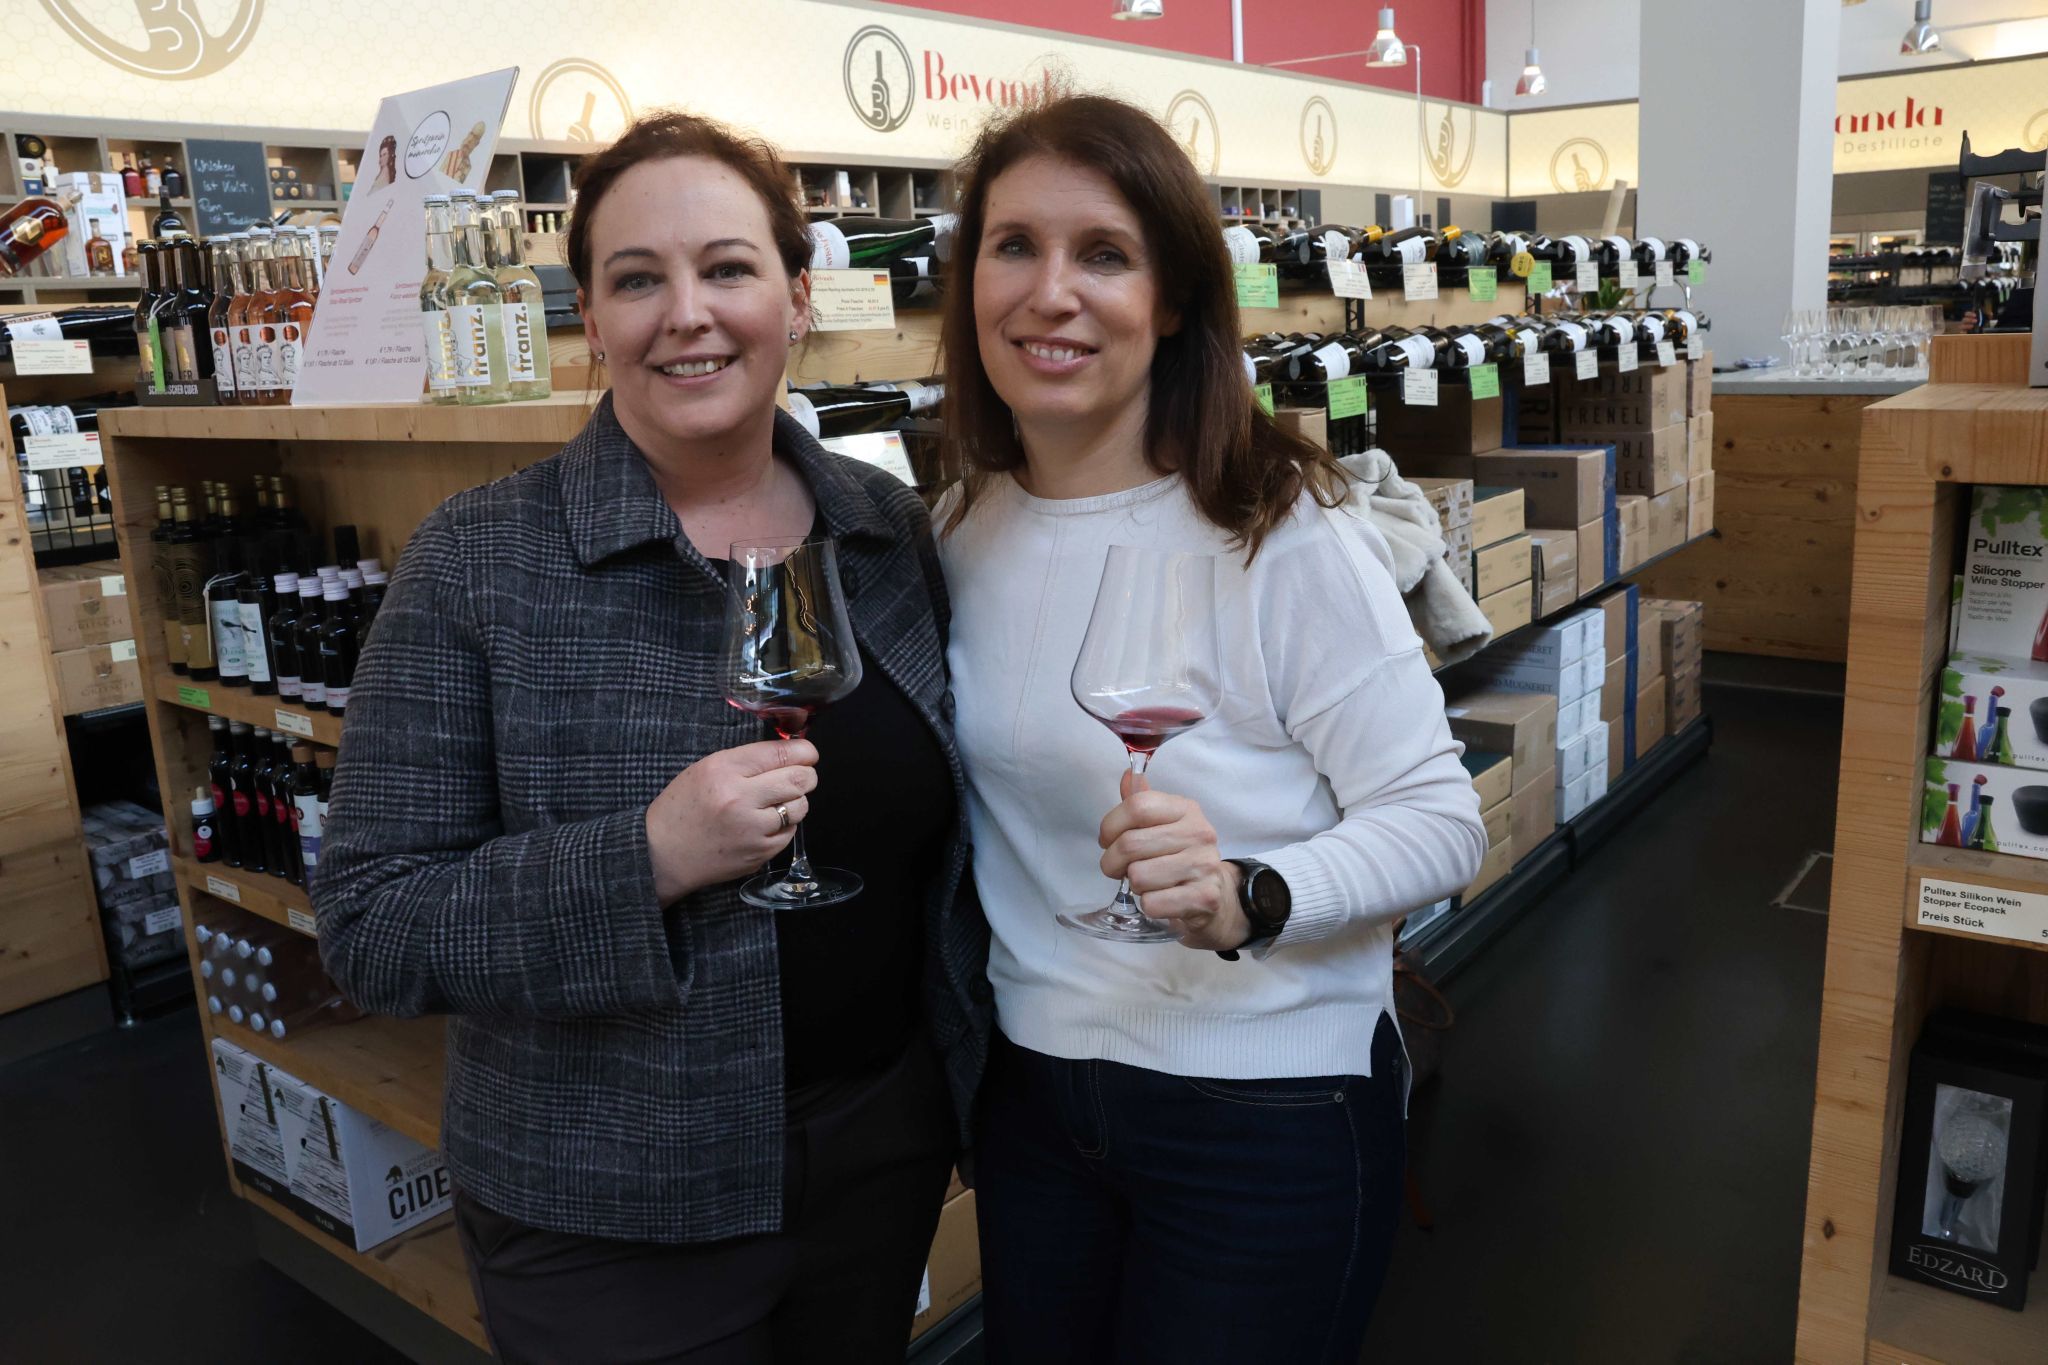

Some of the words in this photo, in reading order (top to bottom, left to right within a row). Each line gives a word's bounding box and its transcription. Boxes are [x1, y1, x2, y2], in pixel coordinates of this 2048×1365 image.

[924, 50, 1069, 109] Bevand
[928, 112, 969, 130] Wein
[1843, 135, 1943, 154] Destillate
[469, 307, 489, 377] franz.
[512, 305, 533, 373] franz.
[1566, 407, 1643, 425] TRENEL
[1973, 538, 2044, 557] Pulltex
[1972, 564, 2022, 577] Silicone
[1971, 575, 1998, 586] Wine
[2001, 577, 2046, 589] Stopper
[1923, 885, 1957, 898] Pulltex
[1959, 890, 1994, 903] Silikon
[1996, 896, 2022, 908] Wein
[1923, 895, 1962, 910] Stopper
[1964, 901, 2007, 915] Ecopack
[1922, 910, 1950, 923] Preis
[1953, 916, 1985, 928] Stück
[1908, 1246, 2009, 1289] EDZARD
